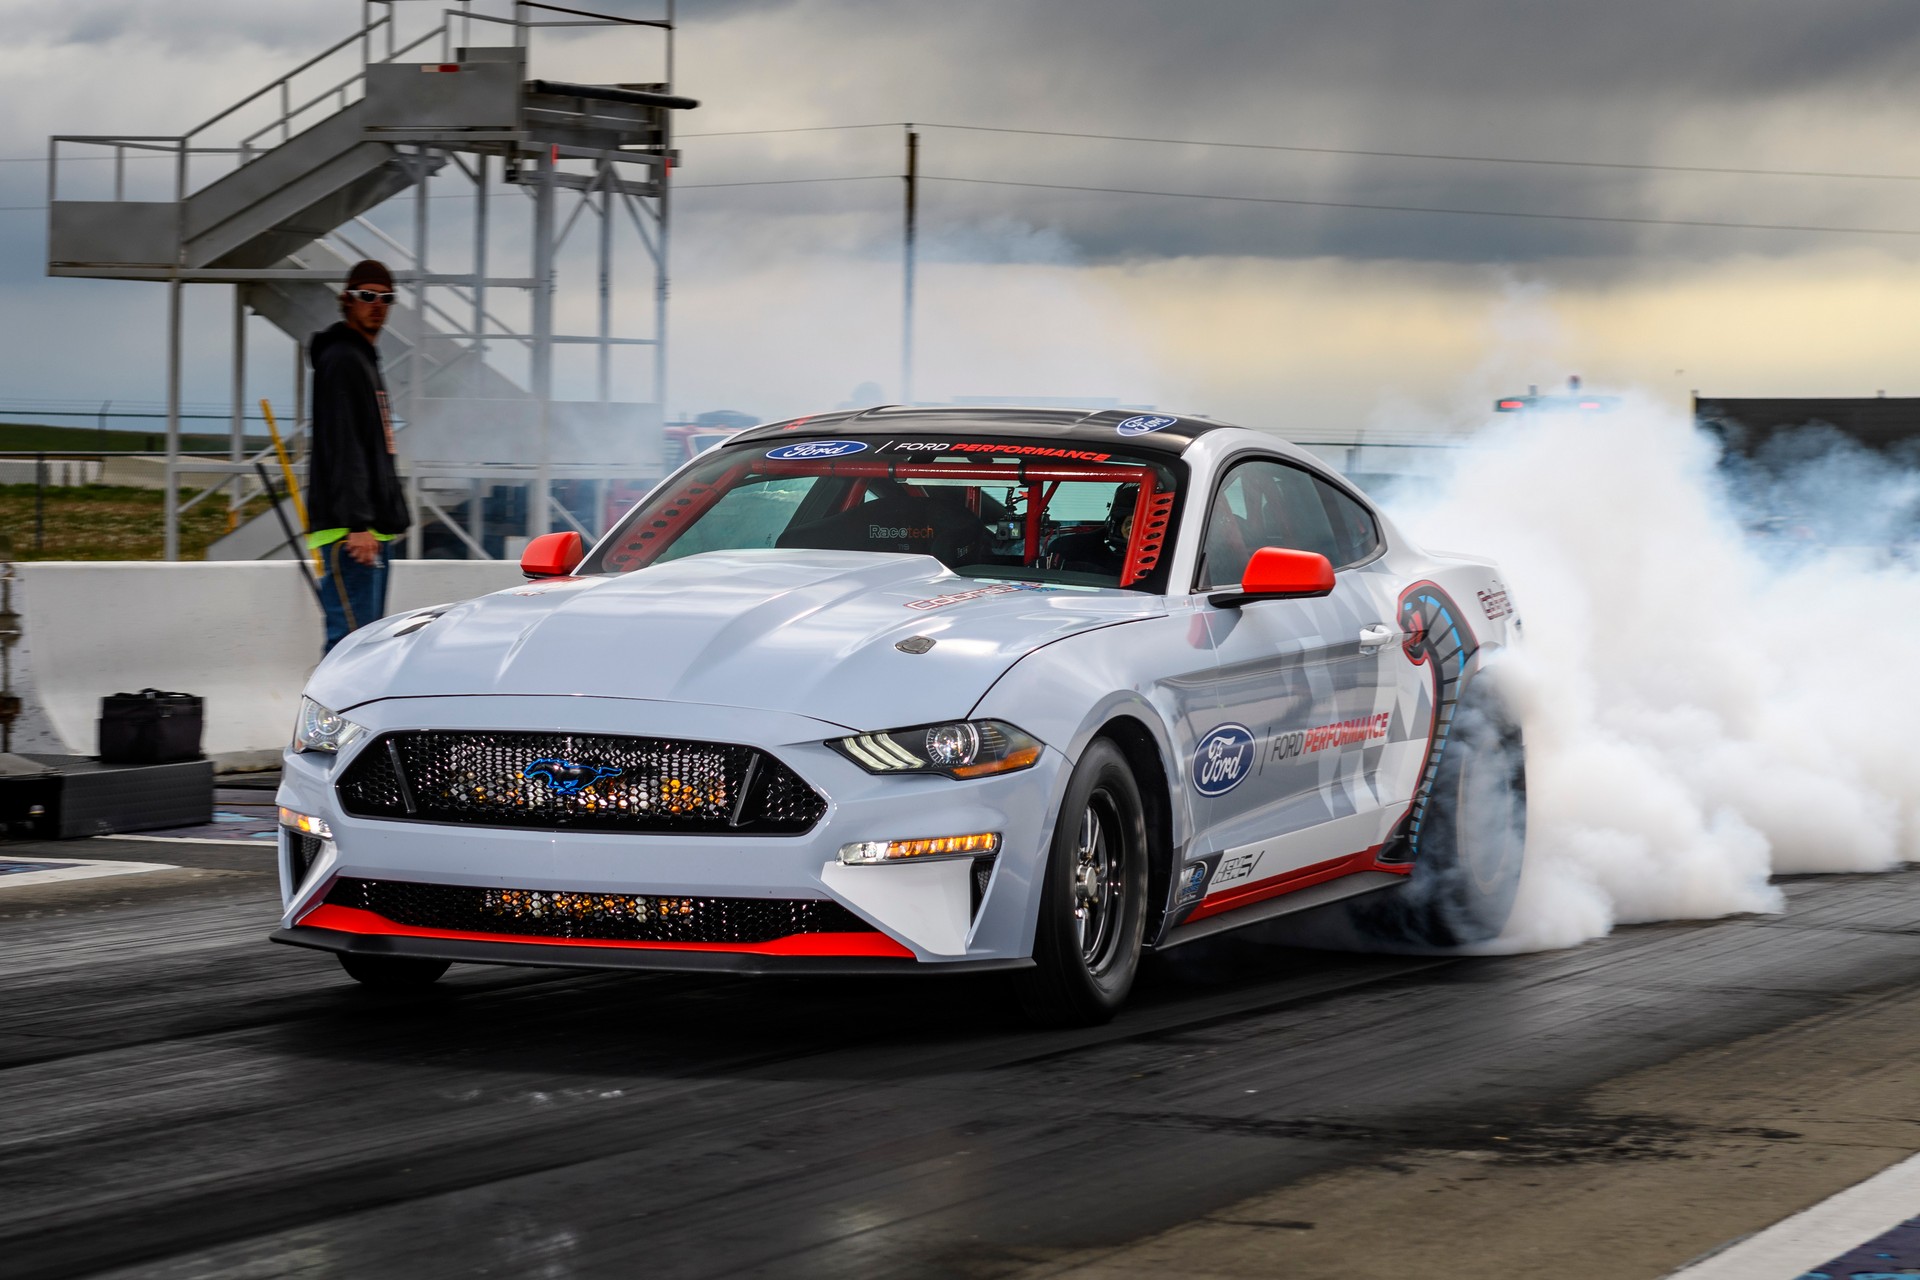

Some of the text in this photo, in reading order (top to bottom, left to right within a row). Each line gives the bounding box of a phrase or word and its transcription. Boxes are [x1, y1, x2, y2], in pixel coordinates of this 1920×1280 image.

[1125, 416, 1171, 431] Ford
[783, 442, 1111, 462] Ford FORD PERFORMANCE
[869, 524, 934, 539] Racetech
[1201, 712, 1389, 785] Ford FORD PERFORMANCE
